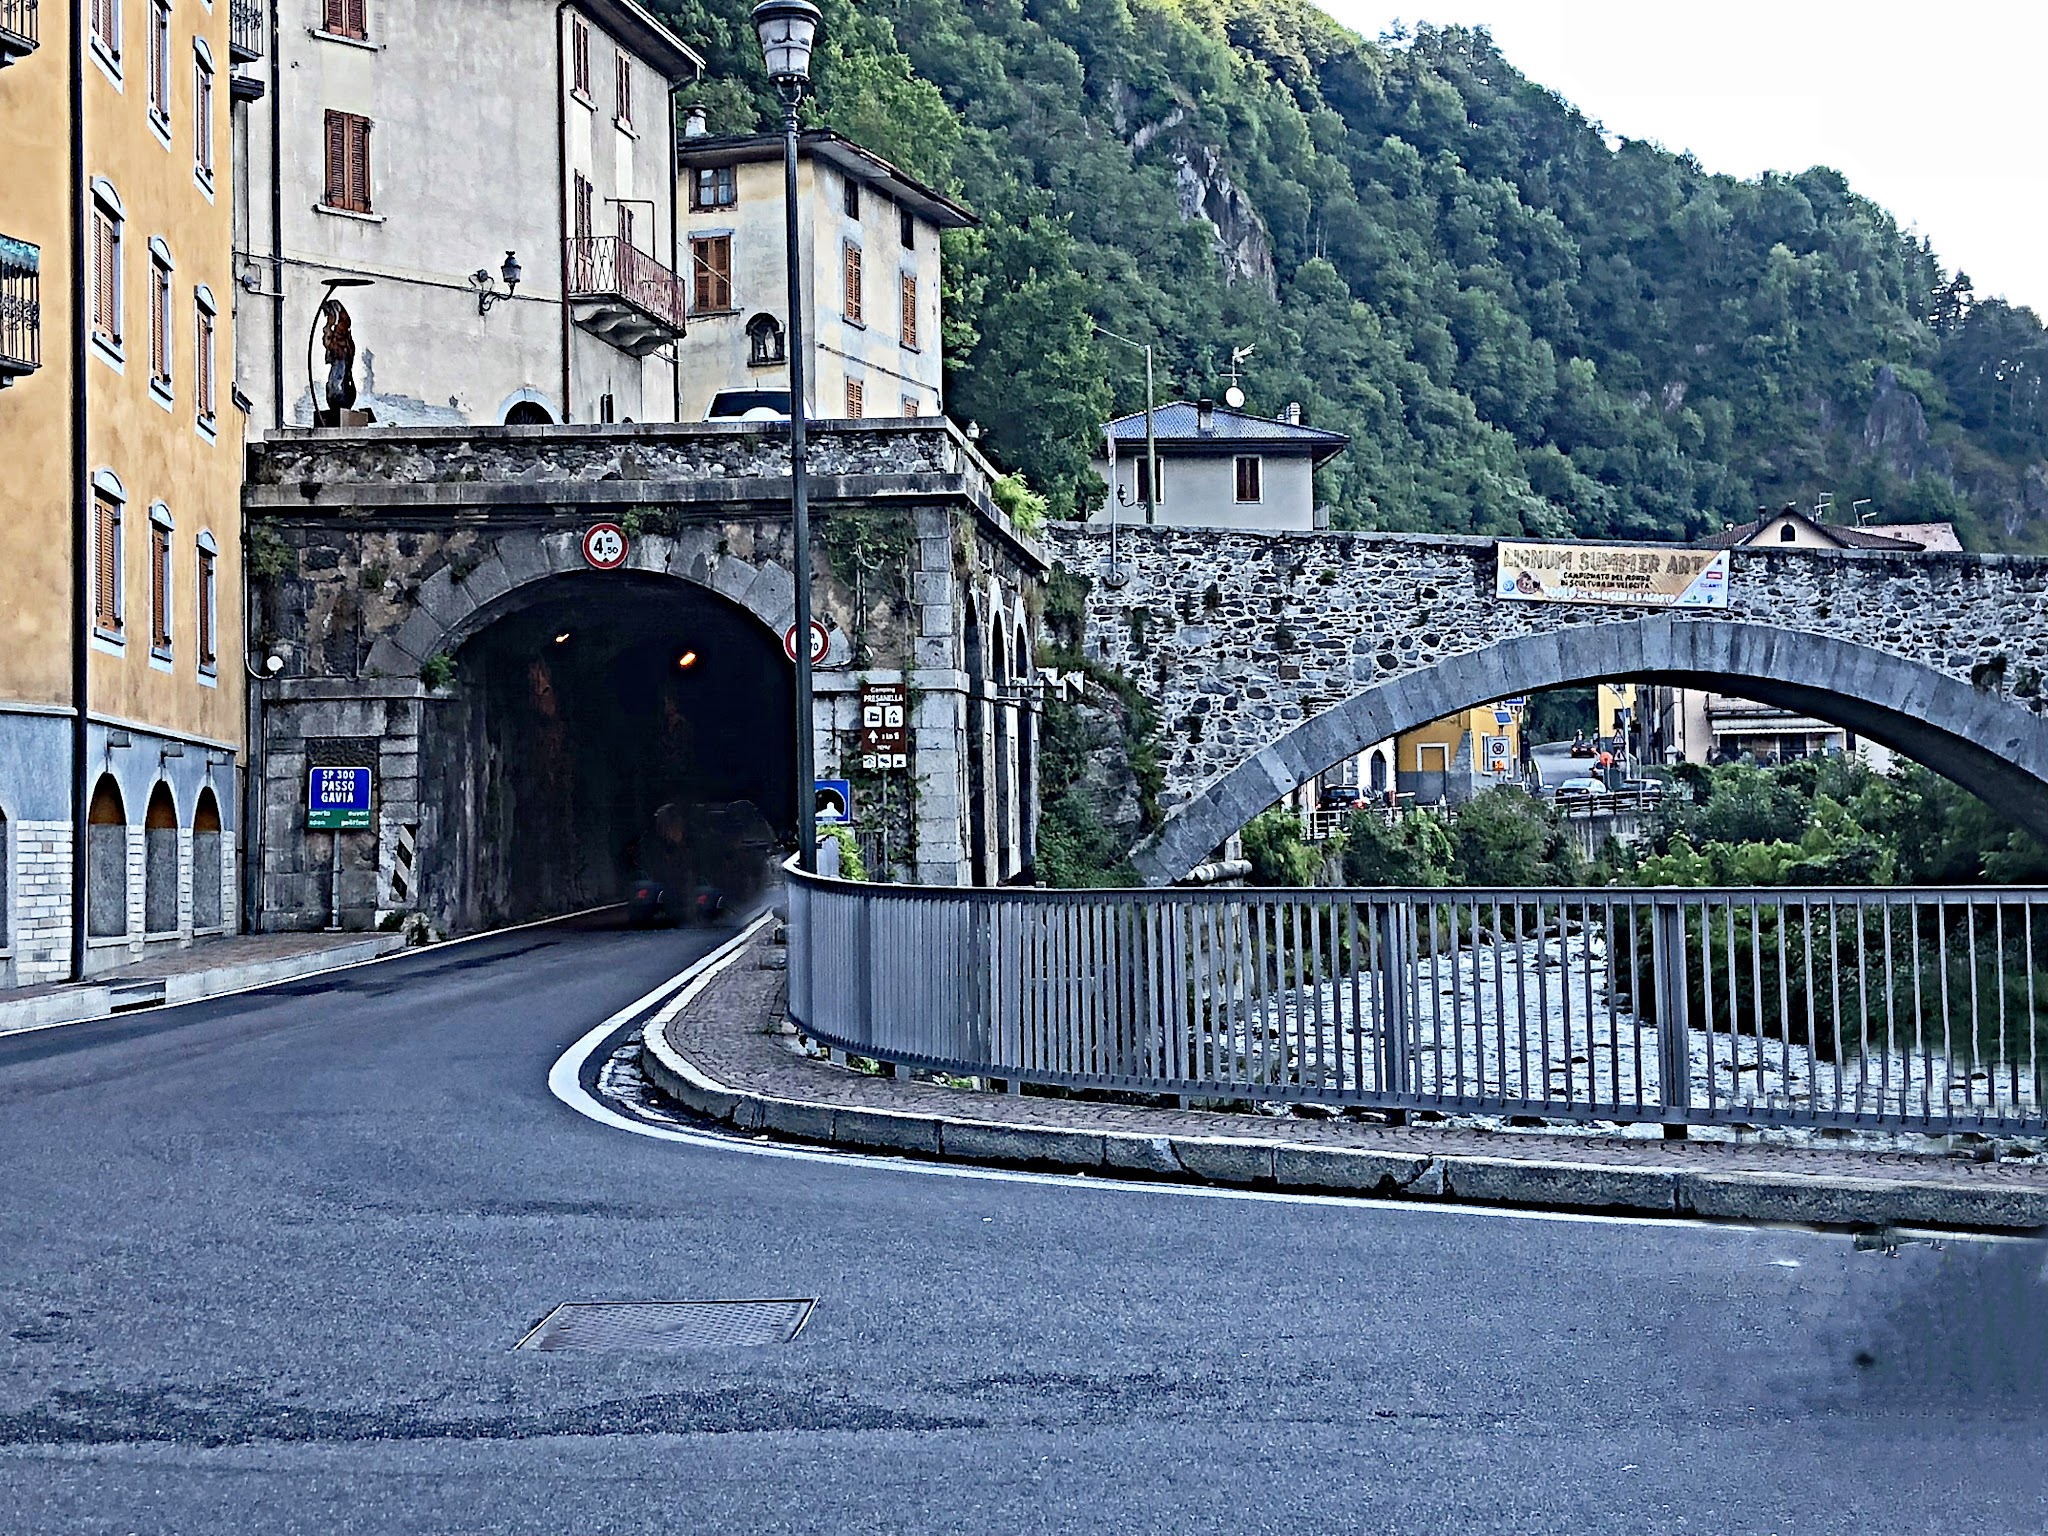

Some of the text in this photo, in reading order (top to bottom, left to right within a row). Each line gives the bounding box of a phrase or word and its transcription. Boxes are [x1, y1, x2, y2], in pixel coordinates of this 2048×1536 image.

[1503, 549, 1705, 574] LIGNUM SUMMER ART
[322, 770, 355, 780] SP 300
[321, 780, 355, 791] PASSO
[320, 792, 354, 803] GAVIA
